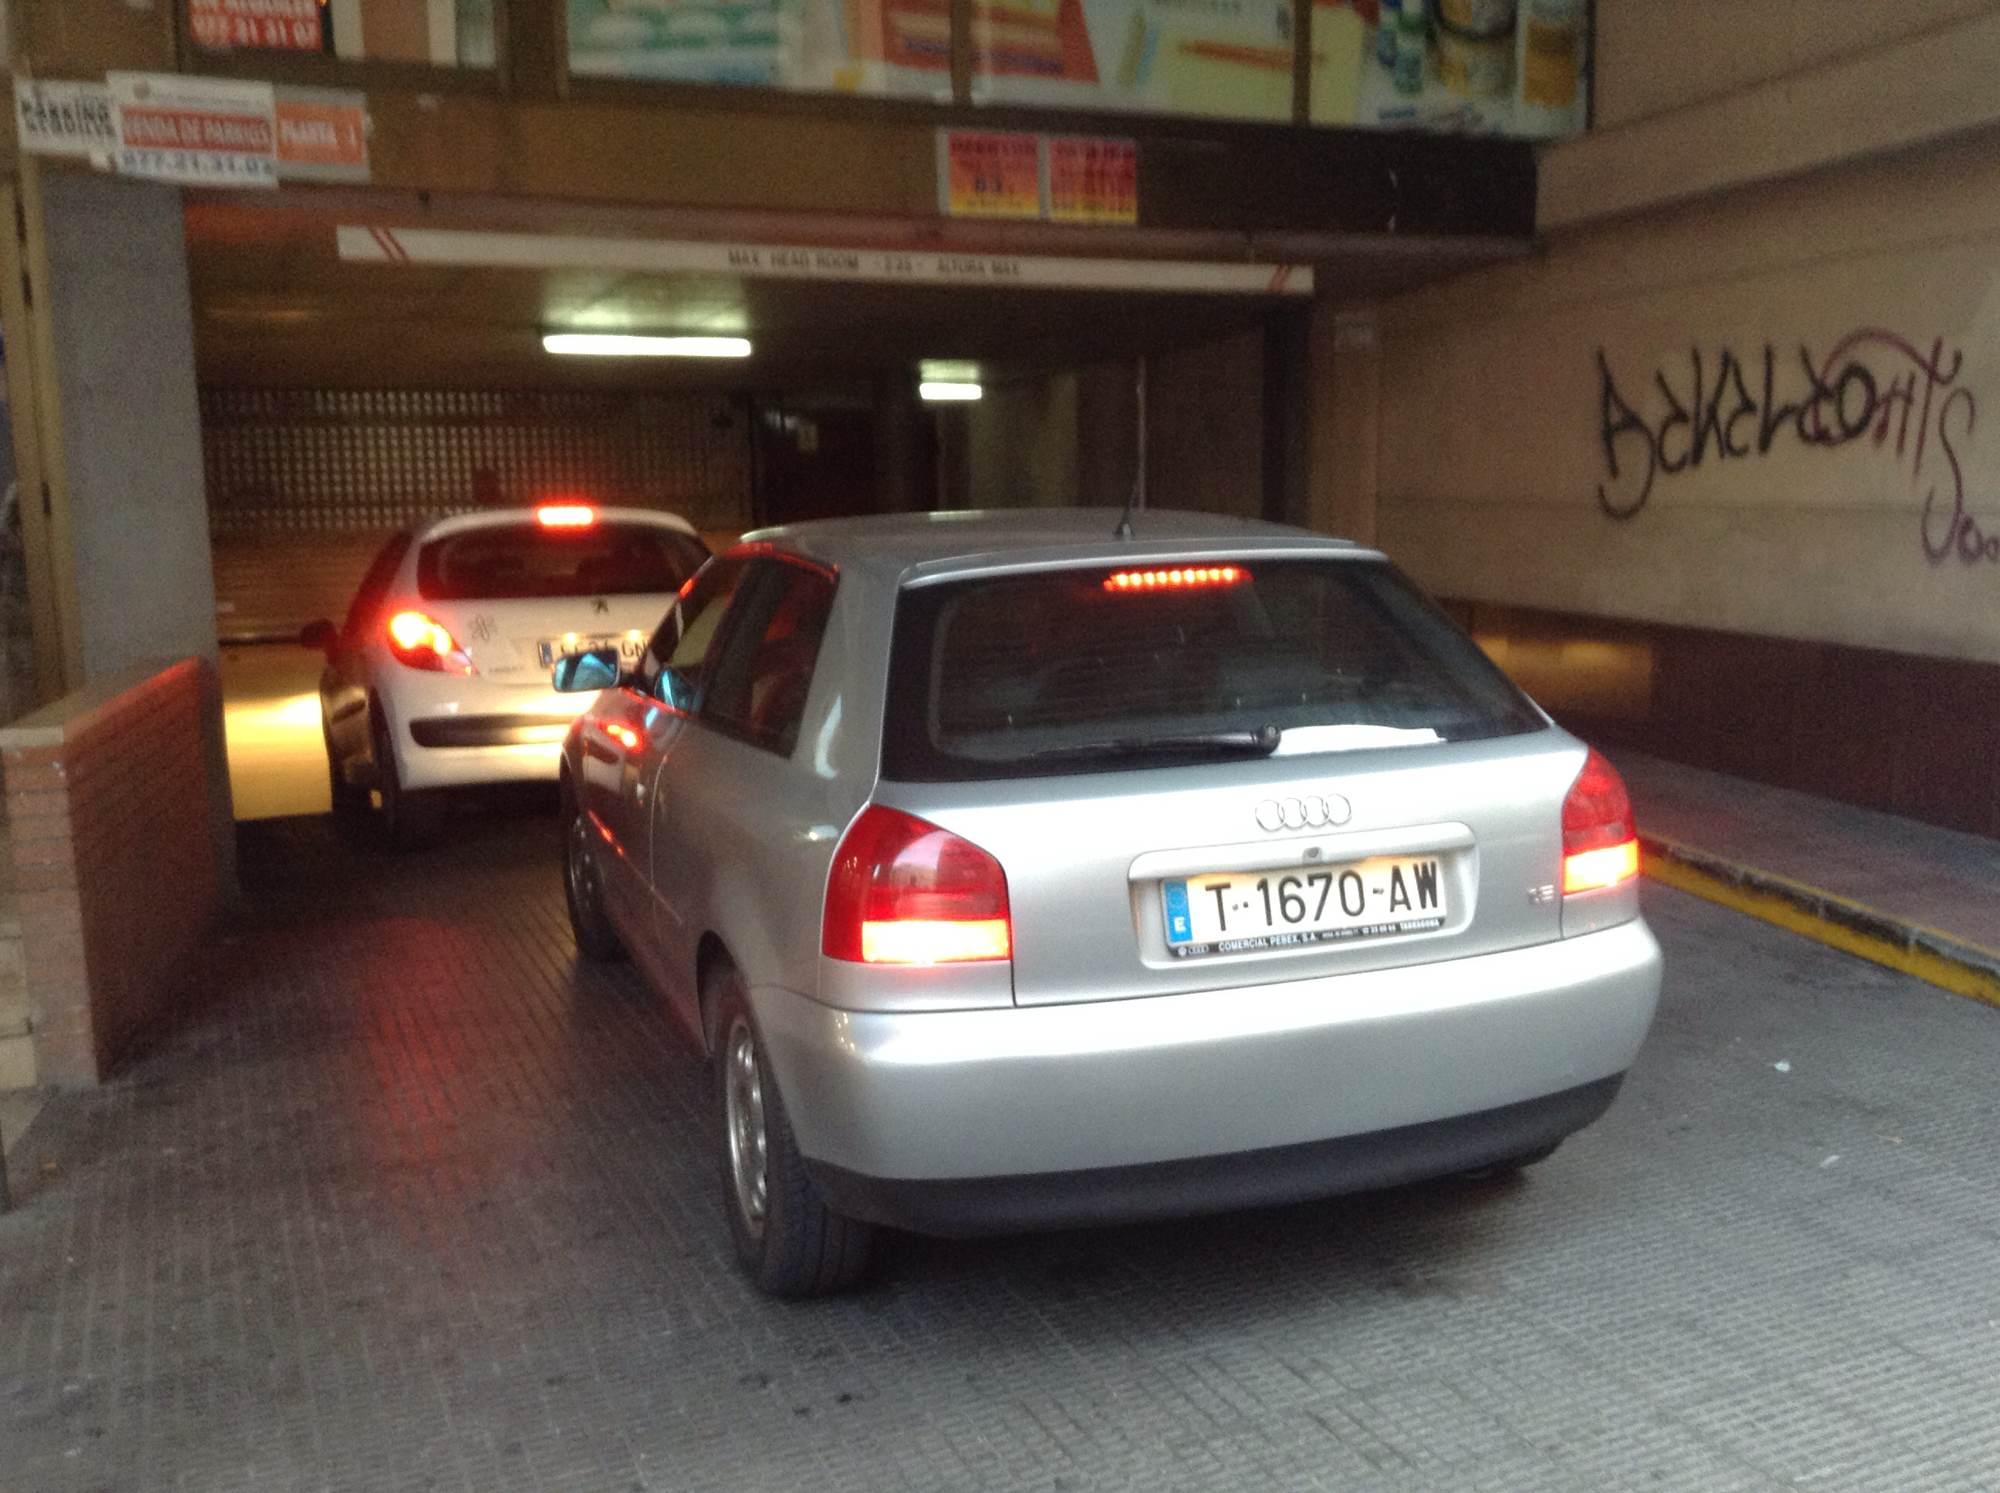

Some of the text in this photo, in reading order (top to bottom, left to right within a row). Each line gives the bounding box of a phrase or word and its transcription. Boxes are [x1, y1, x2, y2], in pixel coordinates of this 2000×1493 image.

[770, 251, 811, 269] HEAD
[816, 252, 860, 271] ROOM
[1173, 917, 1187, 931] E
[1218, 936, 1268, 951] COMERCIAL
